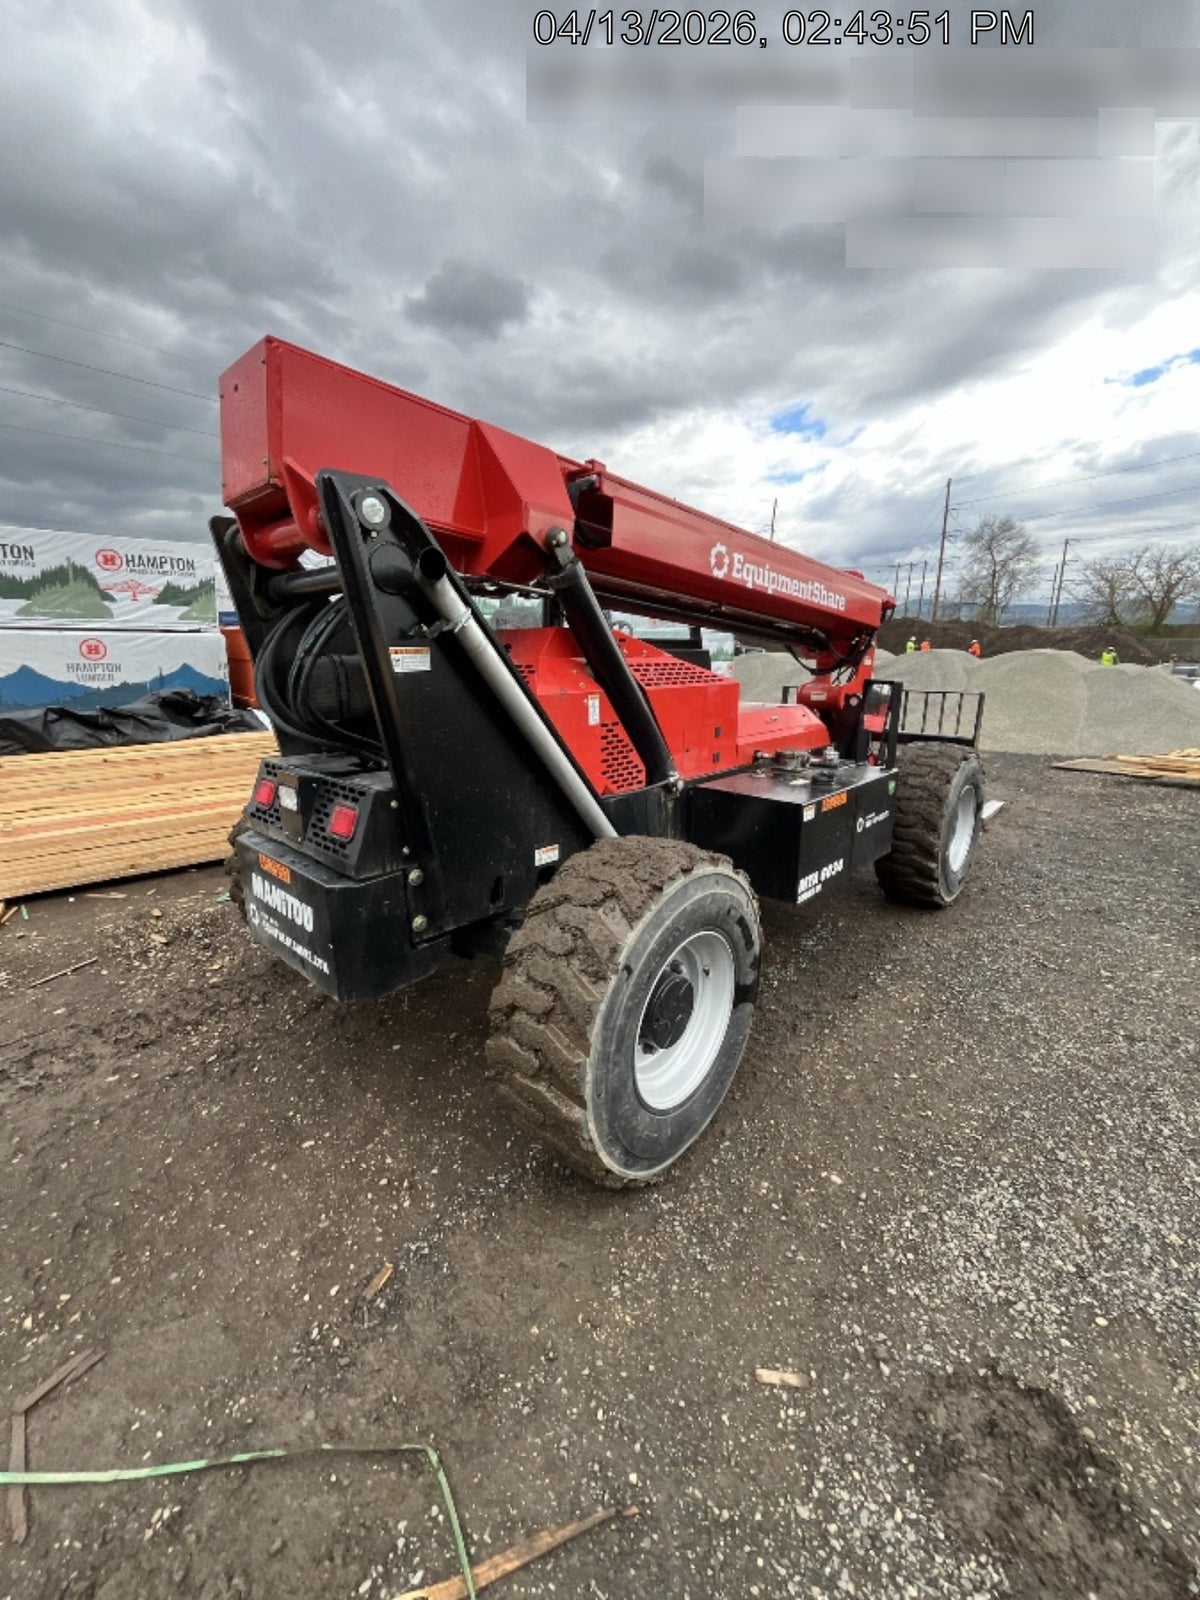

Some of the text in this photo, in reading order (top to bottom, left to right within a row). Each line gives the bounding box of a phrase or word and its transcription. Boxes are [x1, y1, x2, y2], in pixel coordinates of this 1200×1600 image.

[125, 553, 196, 571] HAMPTON
[731, 552, 846, 611] EquipmentShare
[66, 662, 122, 673] HAMPTON
